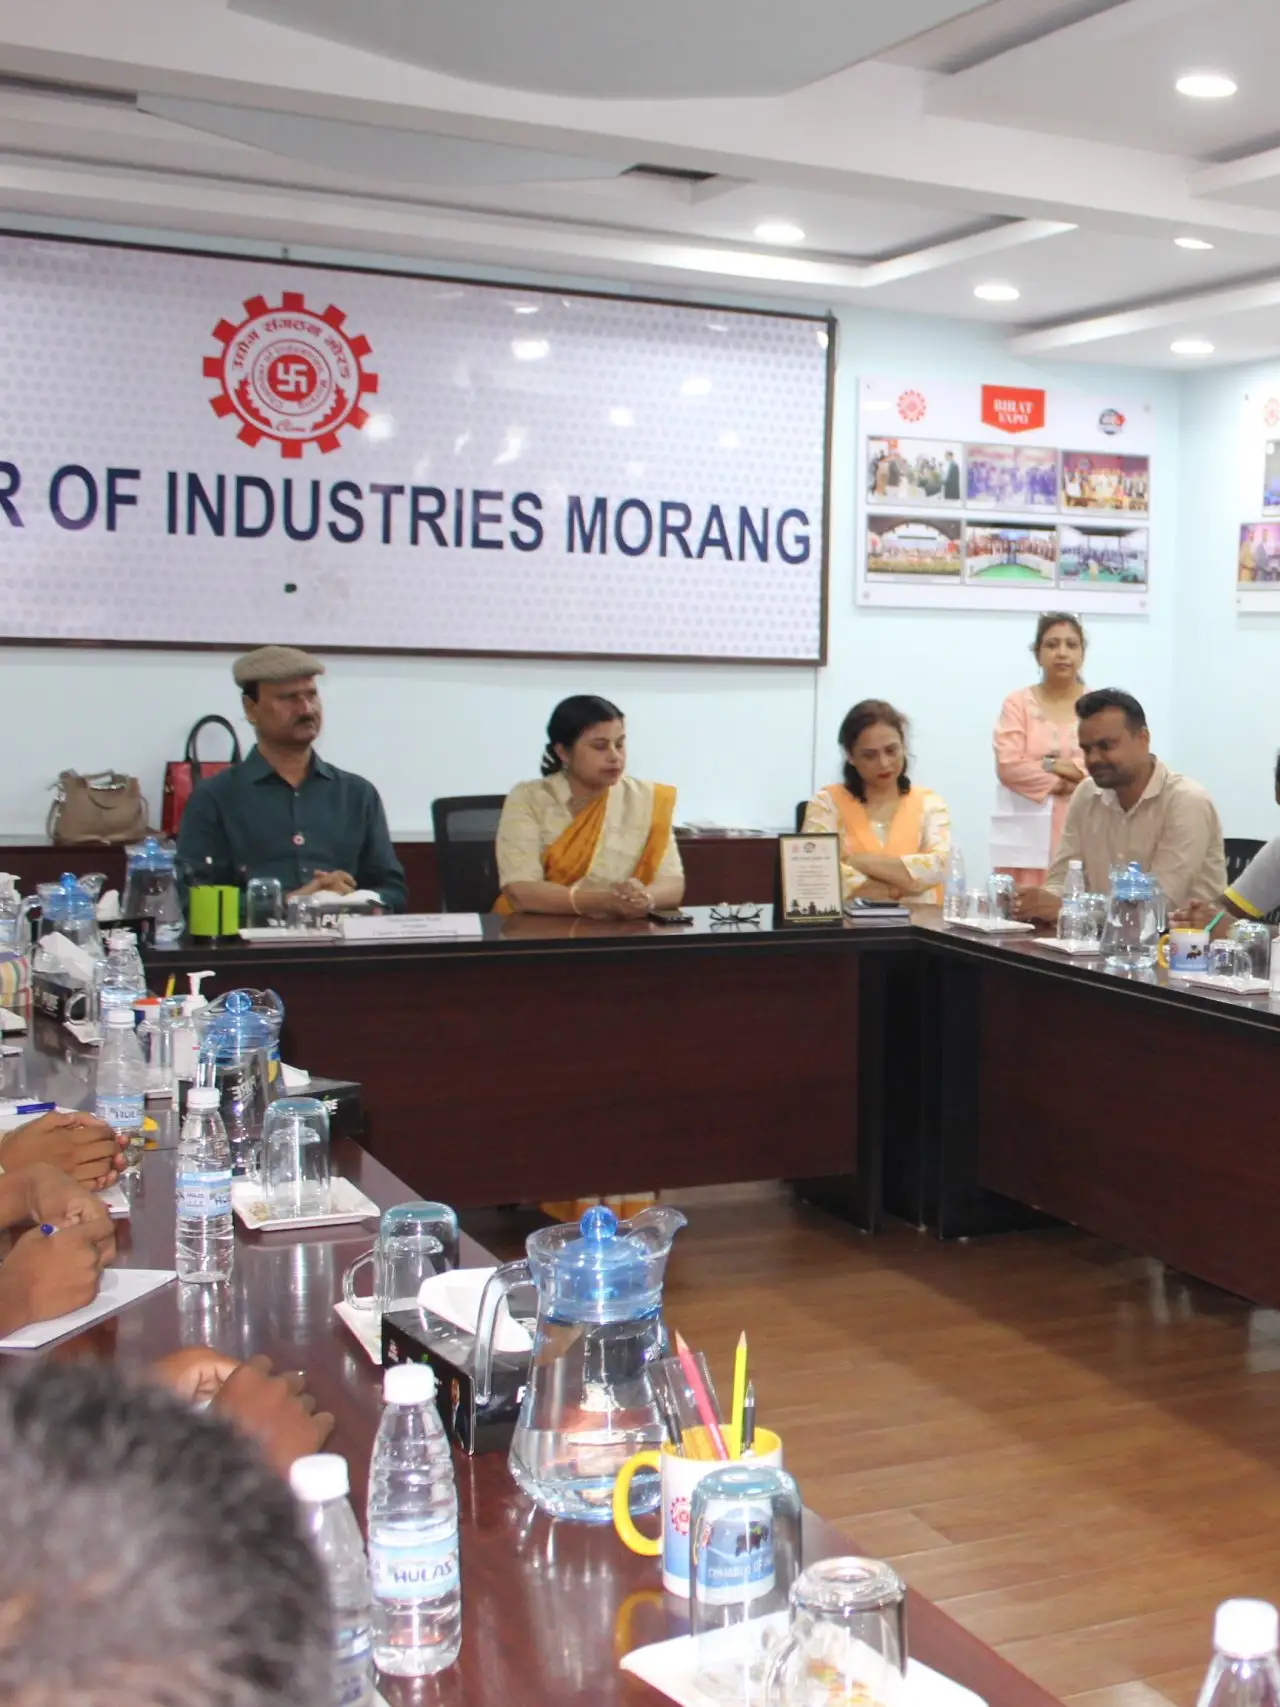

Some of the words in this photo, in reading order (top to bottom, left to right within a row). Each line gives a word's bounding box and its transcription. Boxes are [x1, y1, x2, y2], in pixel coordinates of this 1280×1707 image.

[49, 464, 141, 532] OF
[166, 470, 544, 553] INDUSTRIES
[566, 494, 811, 565] MORANG
[393, 1559, 452, 1583] HULAS
